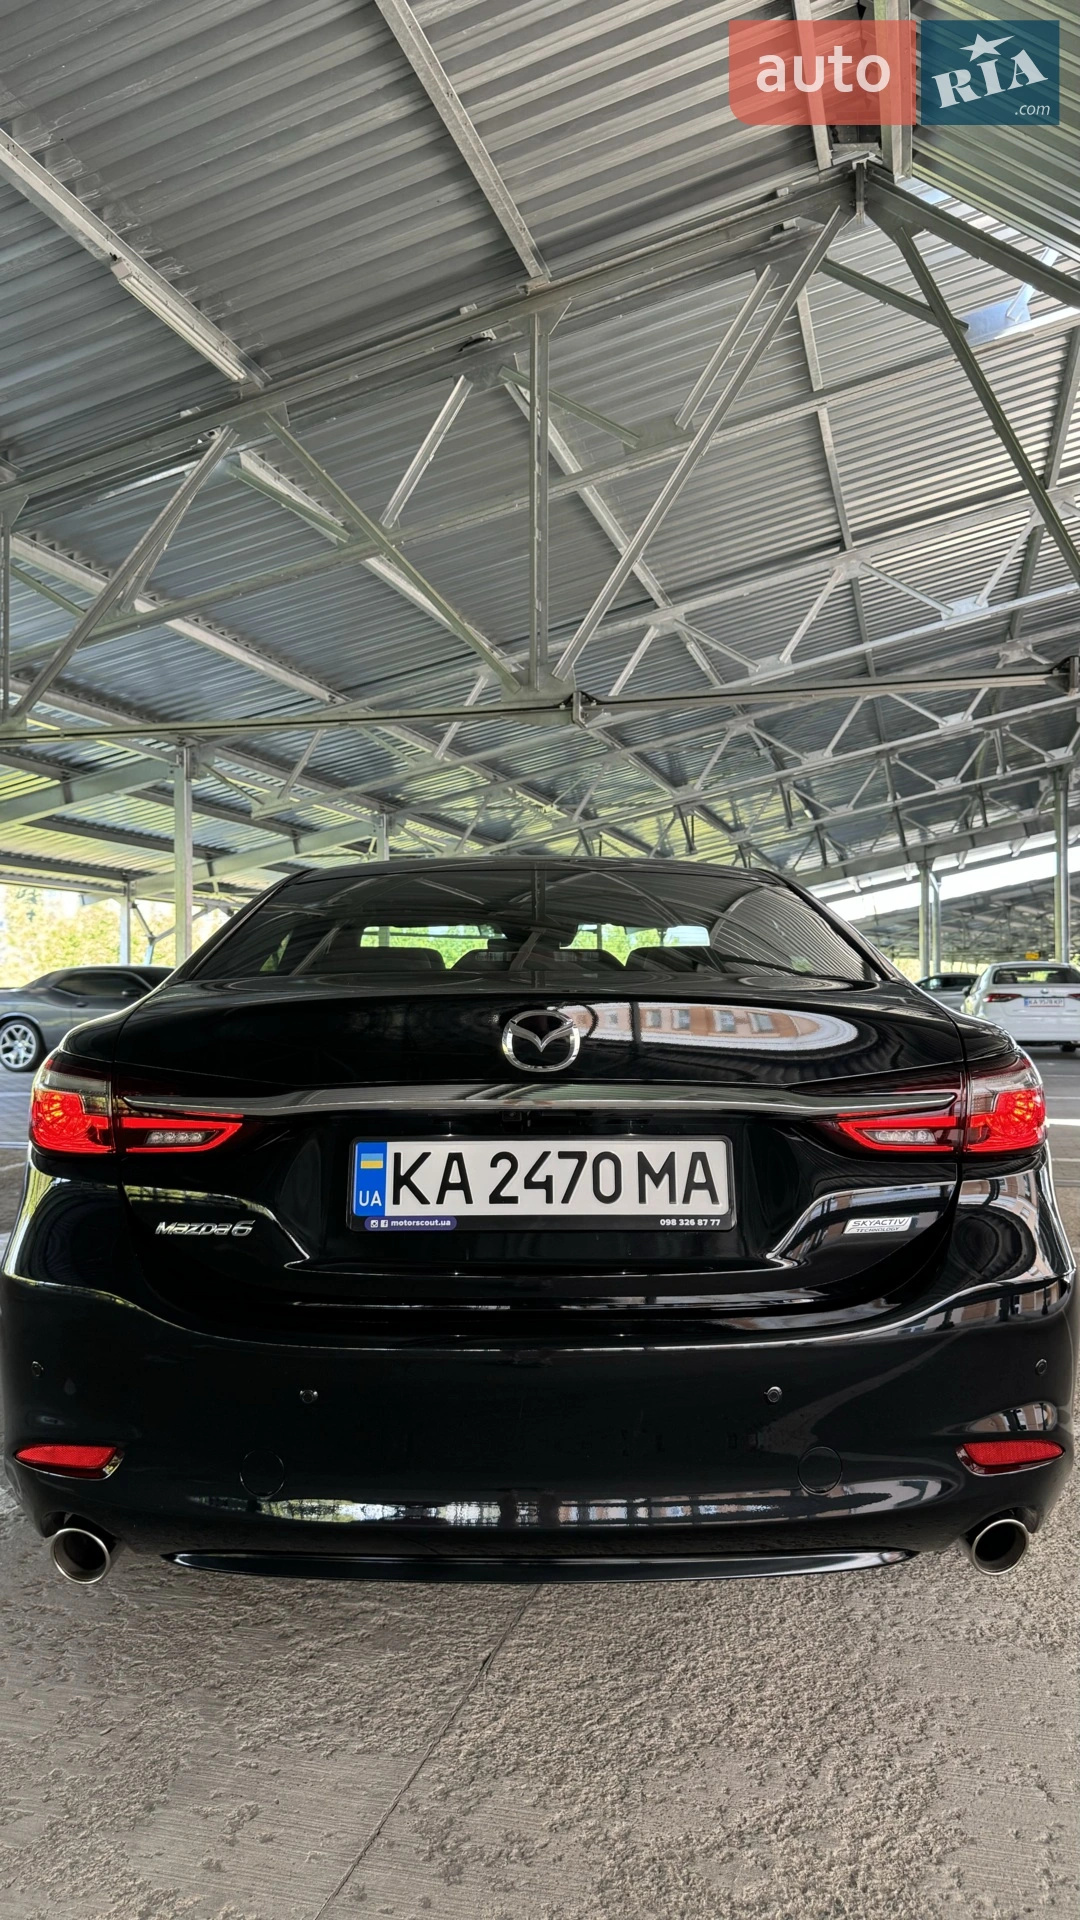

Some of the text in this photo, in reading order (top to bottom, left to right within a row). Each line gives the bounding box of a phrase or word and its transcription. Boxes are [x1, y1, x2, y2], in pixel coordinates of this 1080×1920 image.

[392, 1151, 720, 1205] KA 2470 MA
[359, 1190, 382, 1207] UA
[390, 1219, 451, 1227] motorscout.ua
[660, 1218, 721, 1226] 098 326 87 77
[852, 1218, 906, 1226] SKYACTIV
